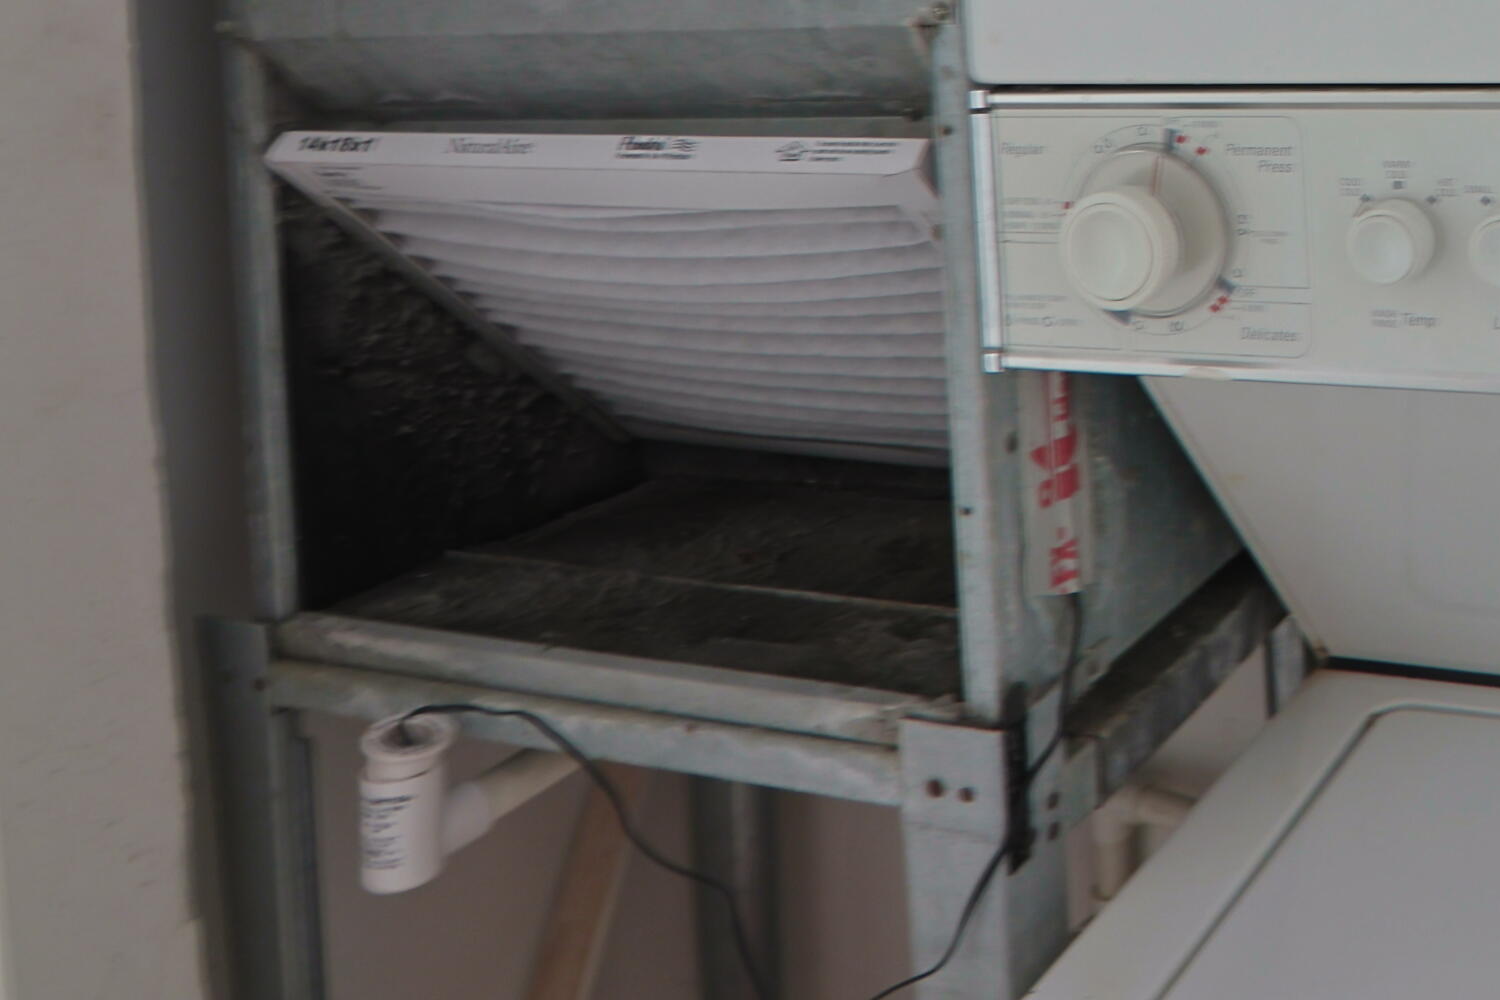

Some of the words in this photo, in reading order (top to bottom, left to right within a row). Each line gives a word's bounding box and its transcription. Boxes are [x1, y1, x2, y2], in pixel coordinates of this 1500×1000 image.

[1225, 144, 1293, 157] Permanent
[1257, 160, 1294, 173] Press
[1402, 312, 1437, 328] Temp
[1240, 326, 1299, 342] Delicates
